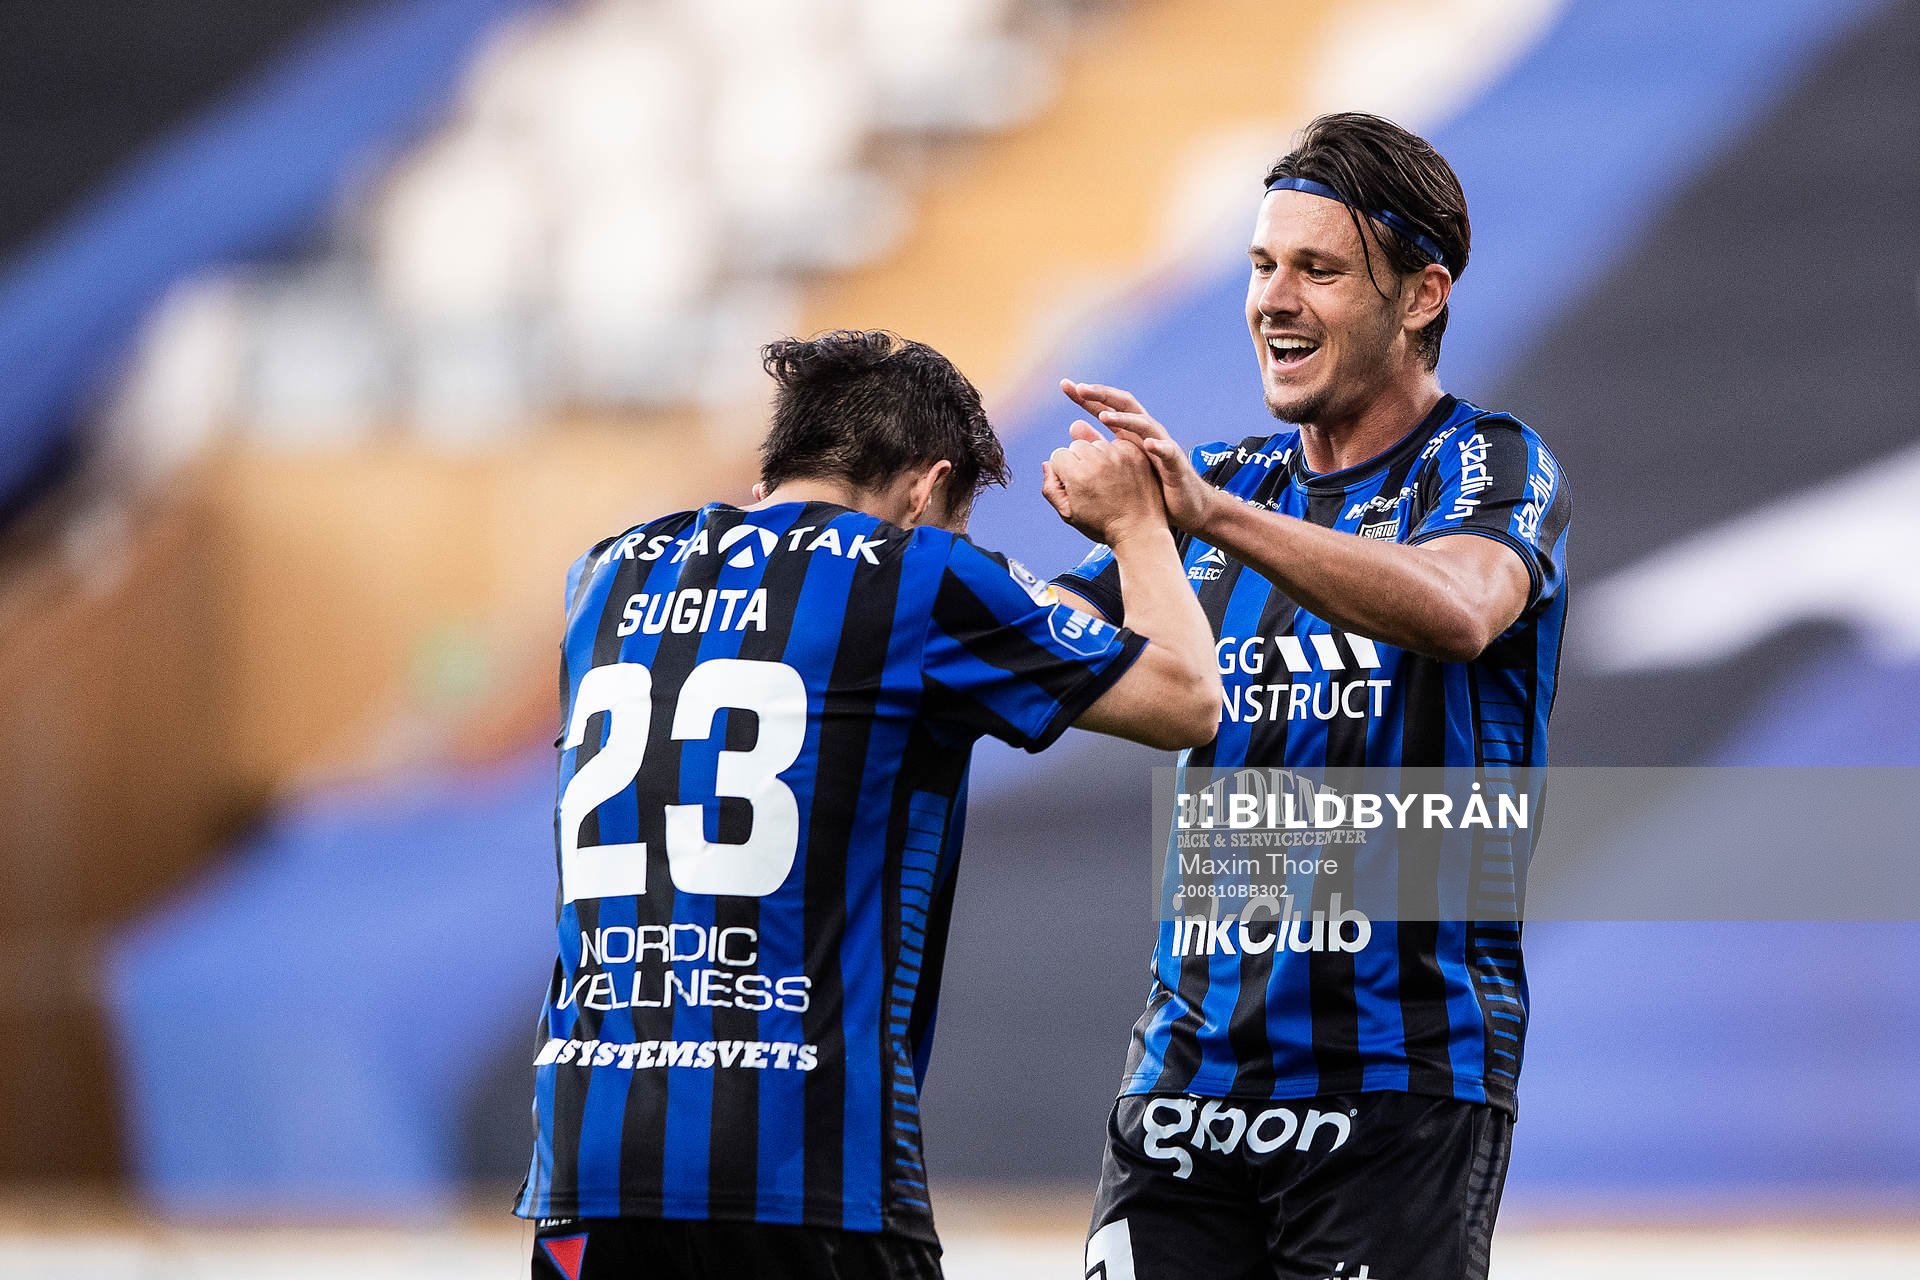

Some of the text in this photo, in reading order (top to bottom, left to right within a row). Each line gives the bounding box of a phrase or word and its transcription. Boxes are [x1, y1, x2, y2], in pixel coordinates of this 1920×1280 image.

[787, 526, 888, 565] TAK
[617, 588, 767, 637] SUGITA
[559, 658, 808, 904] 23
[1176, 829, 1367, 849] DÄCK & SERVICECENTER
[579, 923, 758, 967] NORDIC
[1171, 892, 1372, 957] inkClub
